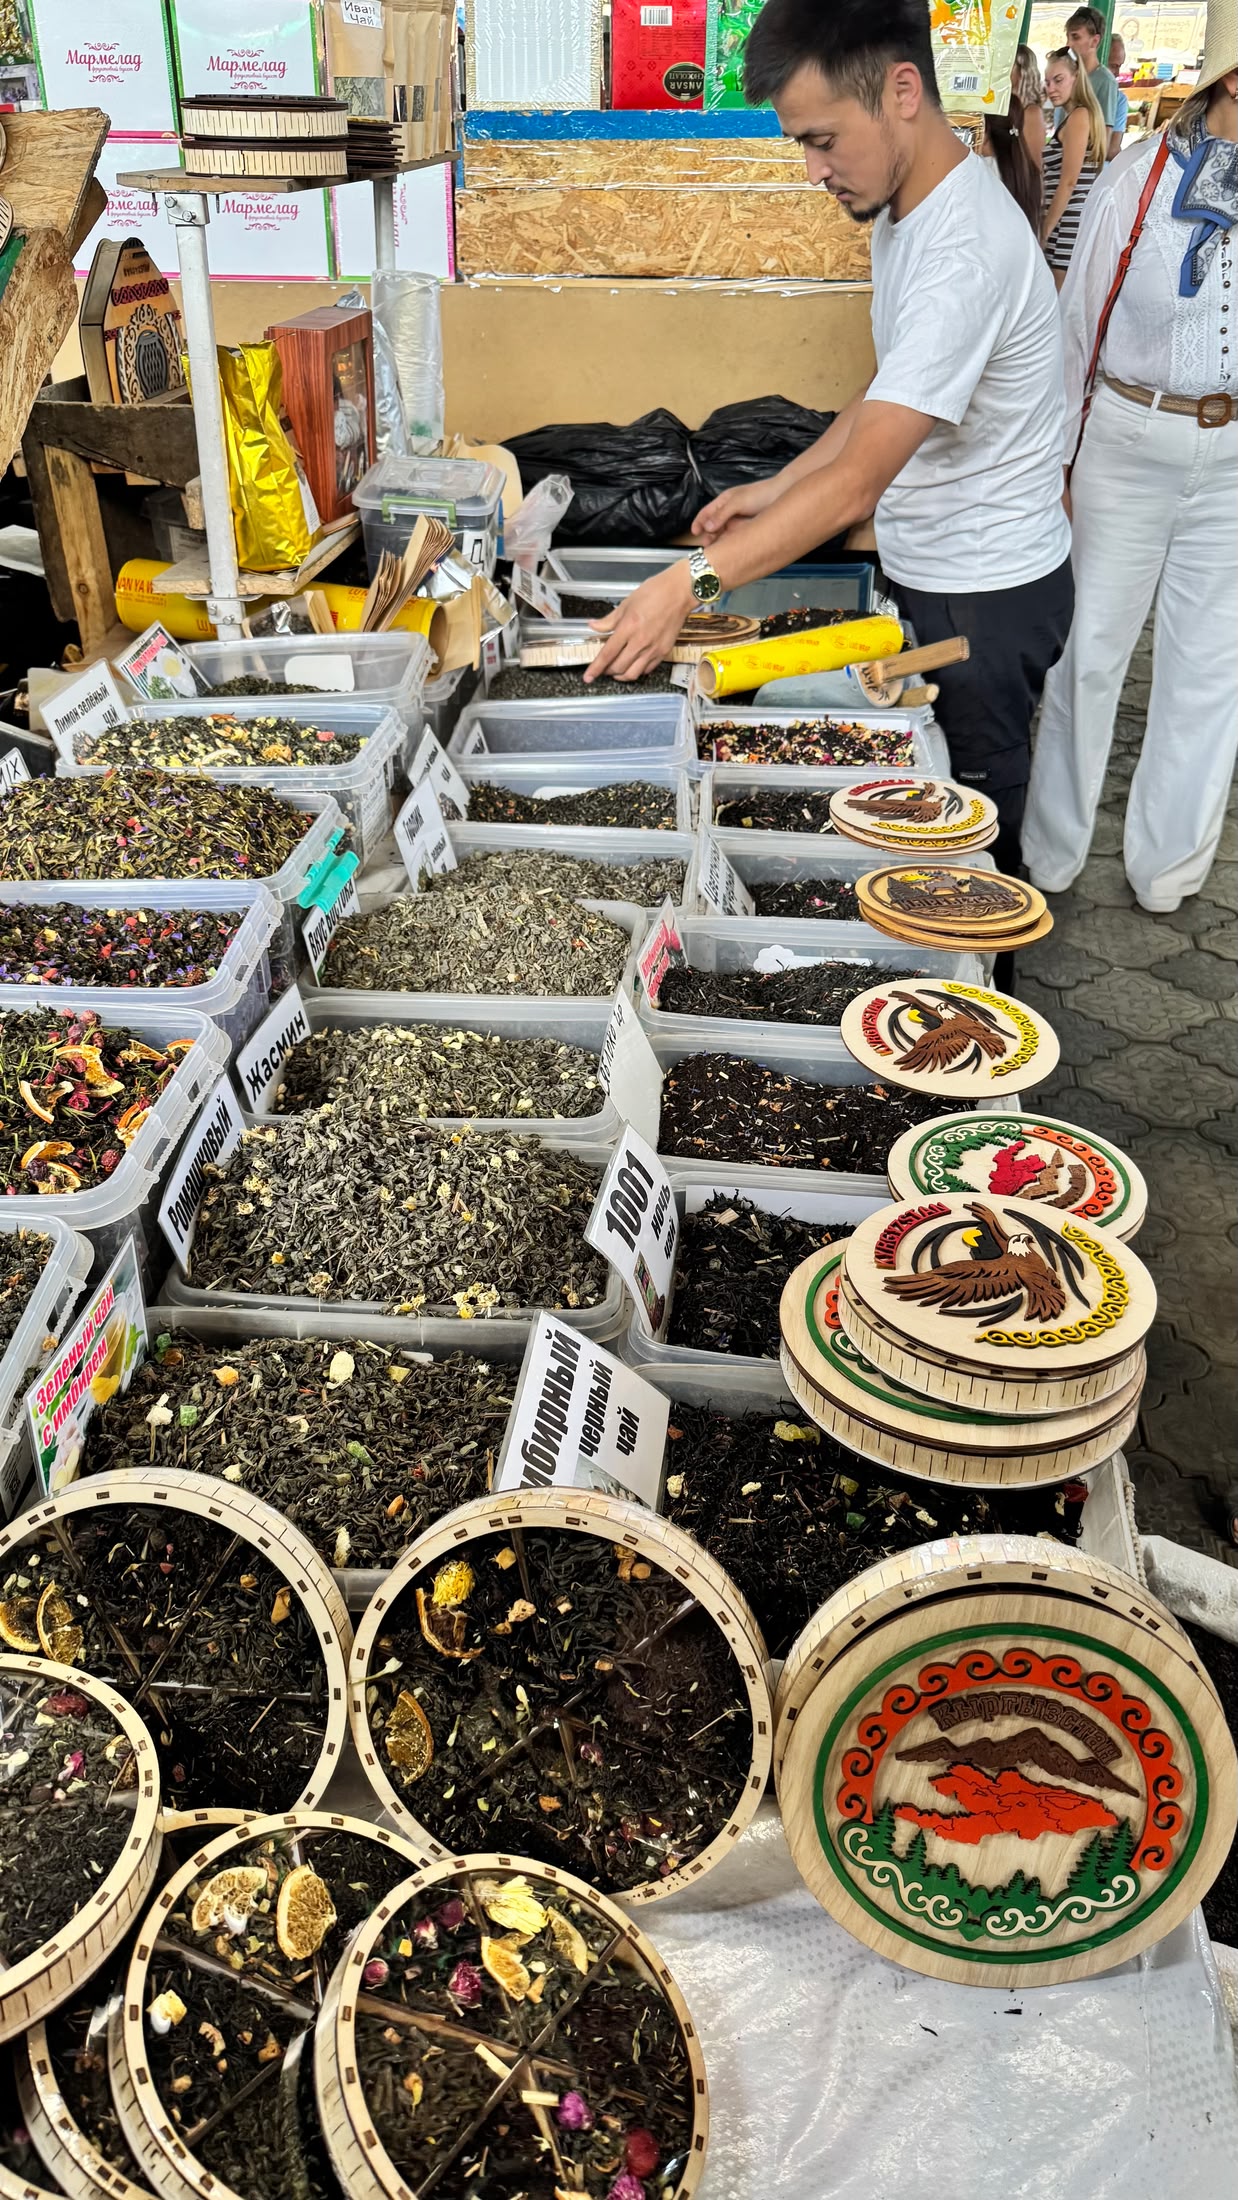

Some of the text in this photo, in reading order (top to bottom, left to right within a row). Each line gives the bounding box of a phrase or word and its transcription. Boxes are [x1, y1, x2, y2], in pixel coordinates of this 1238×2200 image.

[344, 2, 375, 15] Иван
[349, 13, 375, 26] Чай
[65, 49, 143, 72] Мармелад
[206, 55, 288, 79] Мармелад
[105, 199, 160, 218] рмелад
[222, 199, 300, 221] Мармелад
[54, 707, 81, 736] Лимон
[245, 1010, 307, 1102] Жасмин
[605, 1149, 654, 1253] 1001
[874, 1201, 952, 1270] KYRGYZSTAN
[36, 1283, 115, 1417] Зеленый чай
[52, 1338, 108, 1433] имбирем
[519, 1328, 582, 1489] мбирный
[578, 1359, 614, 1458] черный
[616, 1406, 640, 1457] чай
